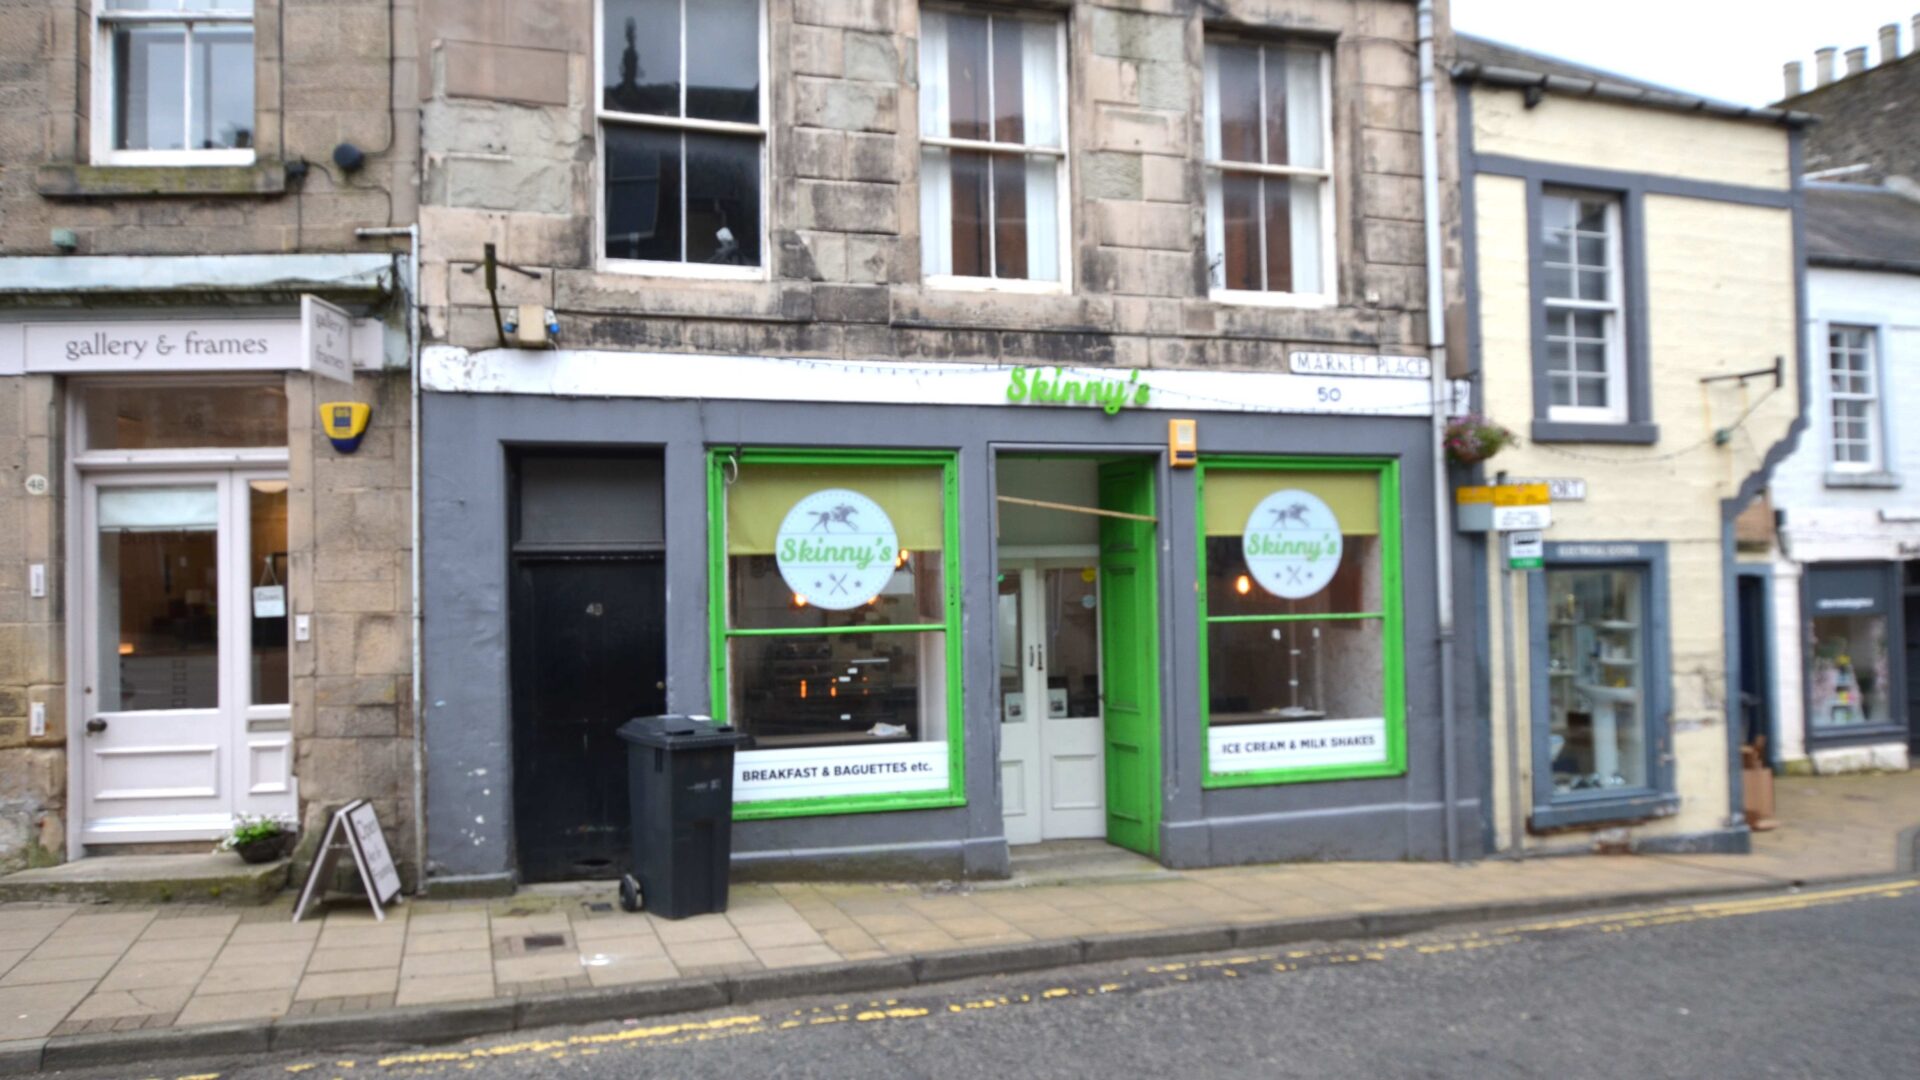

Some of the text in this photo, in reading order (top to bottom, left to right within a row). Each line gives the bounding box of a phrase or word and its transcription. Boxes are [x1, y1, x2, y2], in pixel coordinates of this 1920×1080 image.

[66, 331, 268, 360] gallery & frames
[1297, 353, 1426, 375] MARKET PLACE
[1006, 366, 1150, 415] Skinny's
[1317, 386, 1341, 402] 50
[780, 537, 892, 570] Skinny's
[1247, 532, 1338, 563] Skinny's
[1222, 734, 1375, 755] ICE CREAM & MILK SHAKES
[742, 762, 933, 782] BREAKFAST & BAGUETTES etc.
